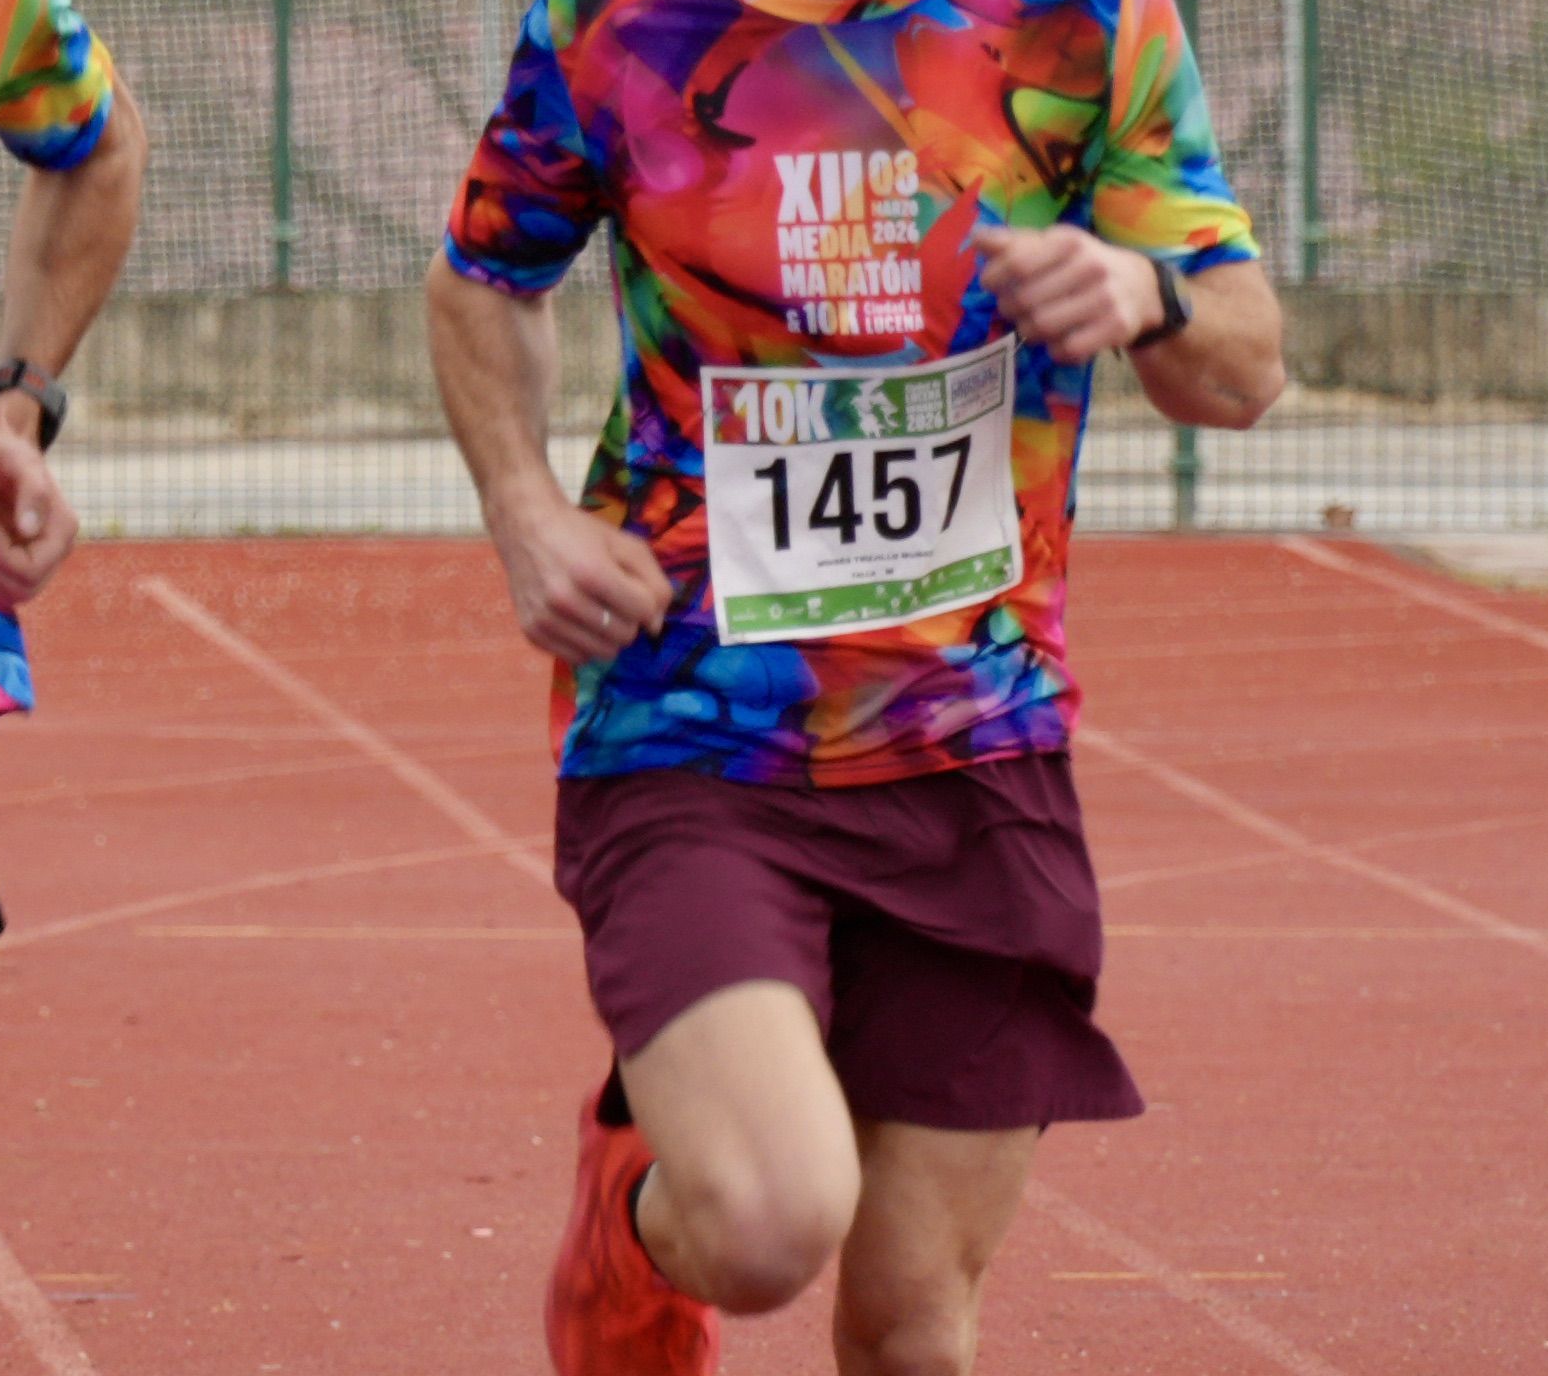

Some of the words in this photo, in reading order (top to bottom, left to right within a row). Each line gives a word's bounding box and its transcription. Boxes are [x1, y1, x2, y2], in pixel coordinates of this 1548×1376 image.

[774, 151, 865, 224] XII
[869, 150, 920, 197] 08
[871, 199, 920, 218] MARZO
[777, 223, 873, 261] MEDIA
[872, 220, 921, 245] 2026
[780, 251, 922, 298] MARATÓN
[803, 300, 860, 336] 10K
[864, 314, 925, 336] LUCENA
[733, 382, 833, 443] 10K
[905, 410, 945, 433] 2026
[754, 434, 972, 551] 1457
